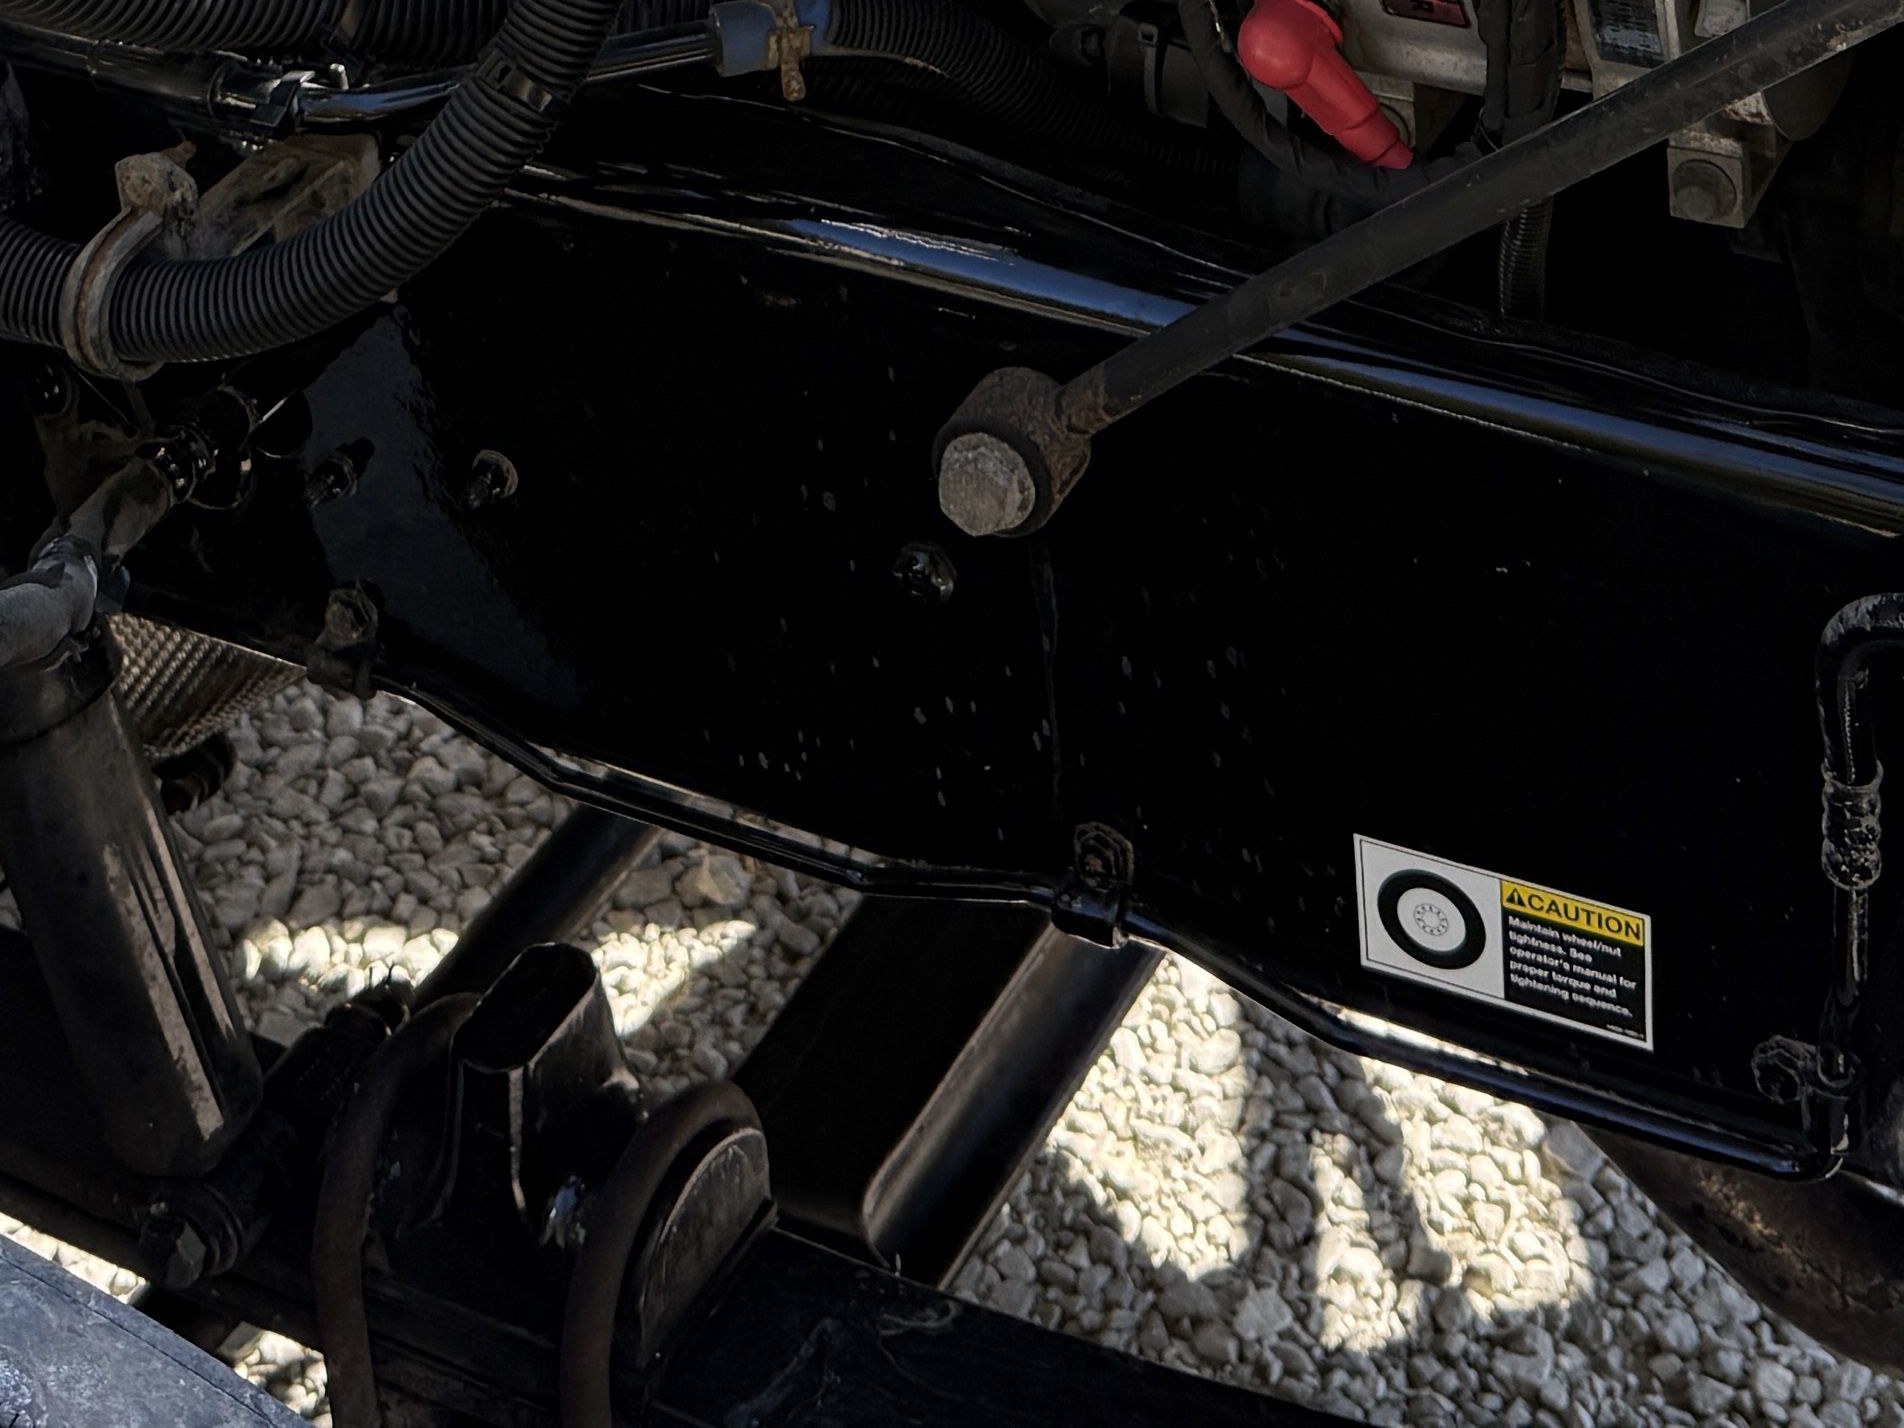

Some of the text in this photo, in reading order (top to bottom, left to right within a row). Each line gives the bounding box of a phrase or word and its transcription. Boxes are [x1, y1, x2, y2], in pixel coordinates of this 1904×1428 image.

[1528, 894, 1641, 940] CAUTION
[1572, 964, 1617, 986] manual
[1620, 977, 1637, 990] for
[1594, 984, 1617, 999] and
